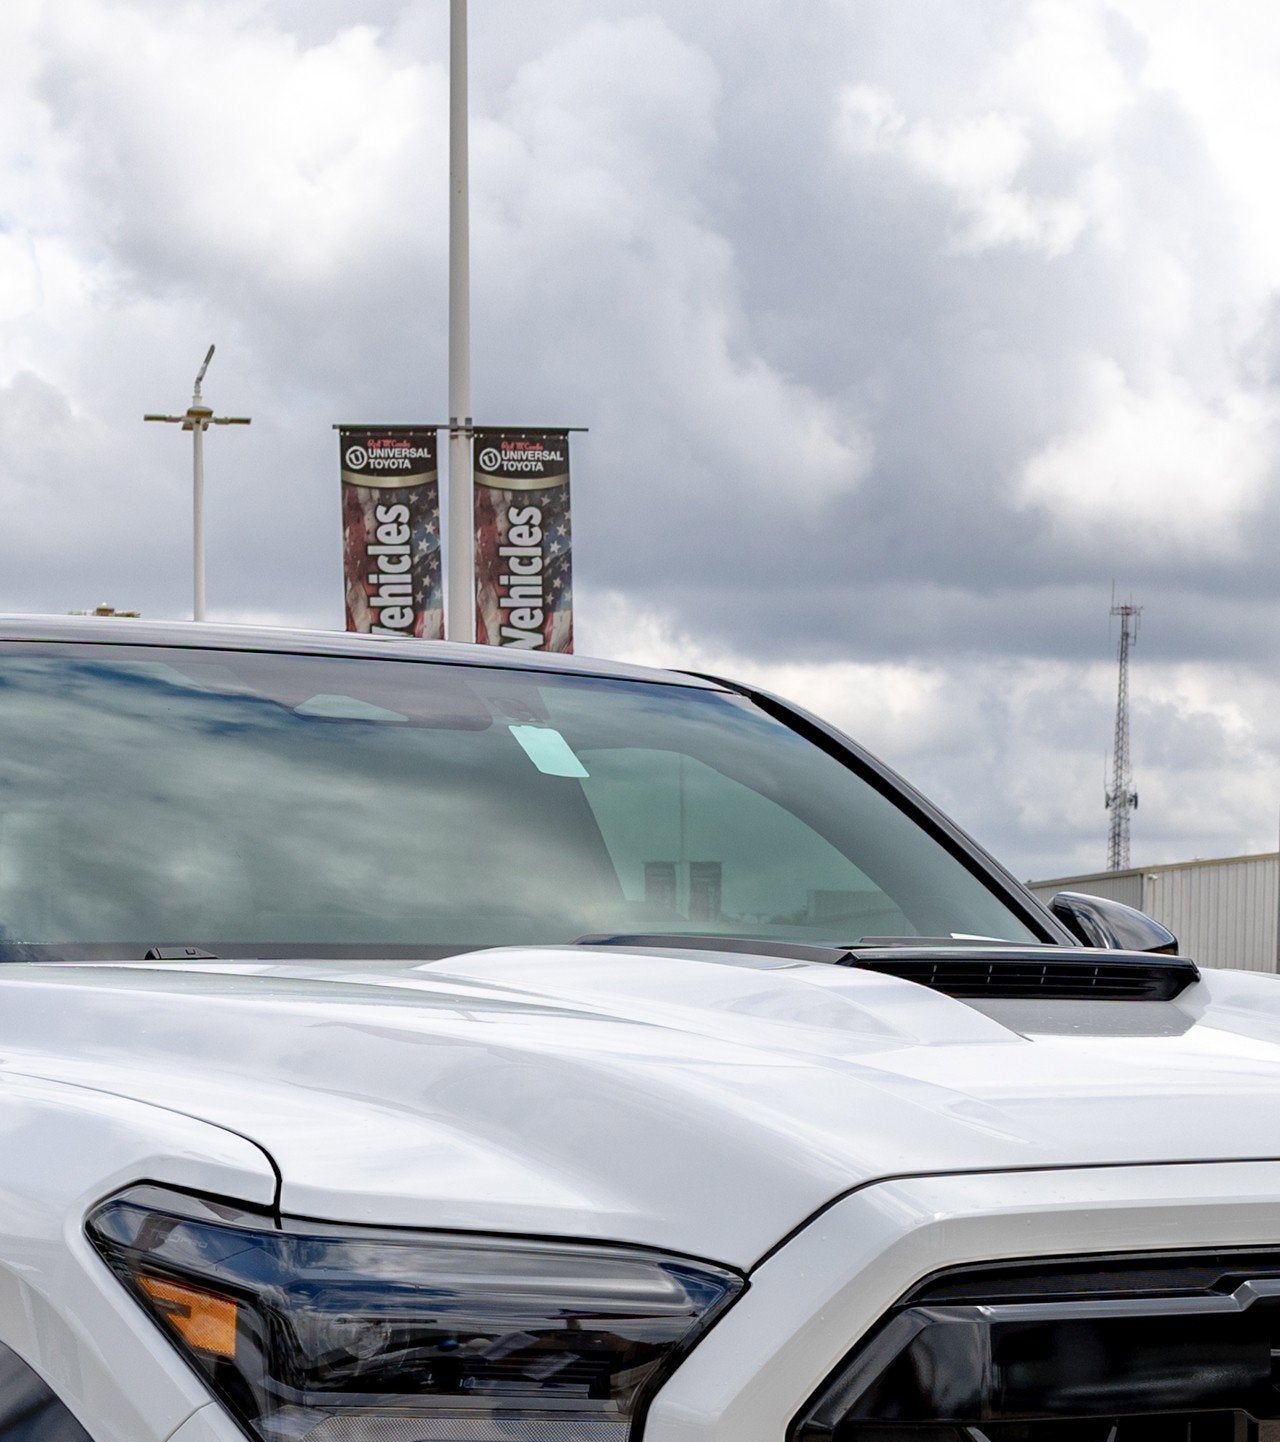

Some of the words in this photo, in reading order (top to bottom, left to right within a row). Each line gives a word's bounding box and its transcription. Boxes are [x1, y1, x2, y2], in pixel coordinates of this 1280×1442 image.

[368, 448, 431, 458] UNIVERSAL
[501, 450, 564, 461] UNIVERSAL
[368, 459, 411, 469] TOYOTA
[501, 461, 544, 471] TOYOTA
[499, 506, 545, 650] Vehicles
